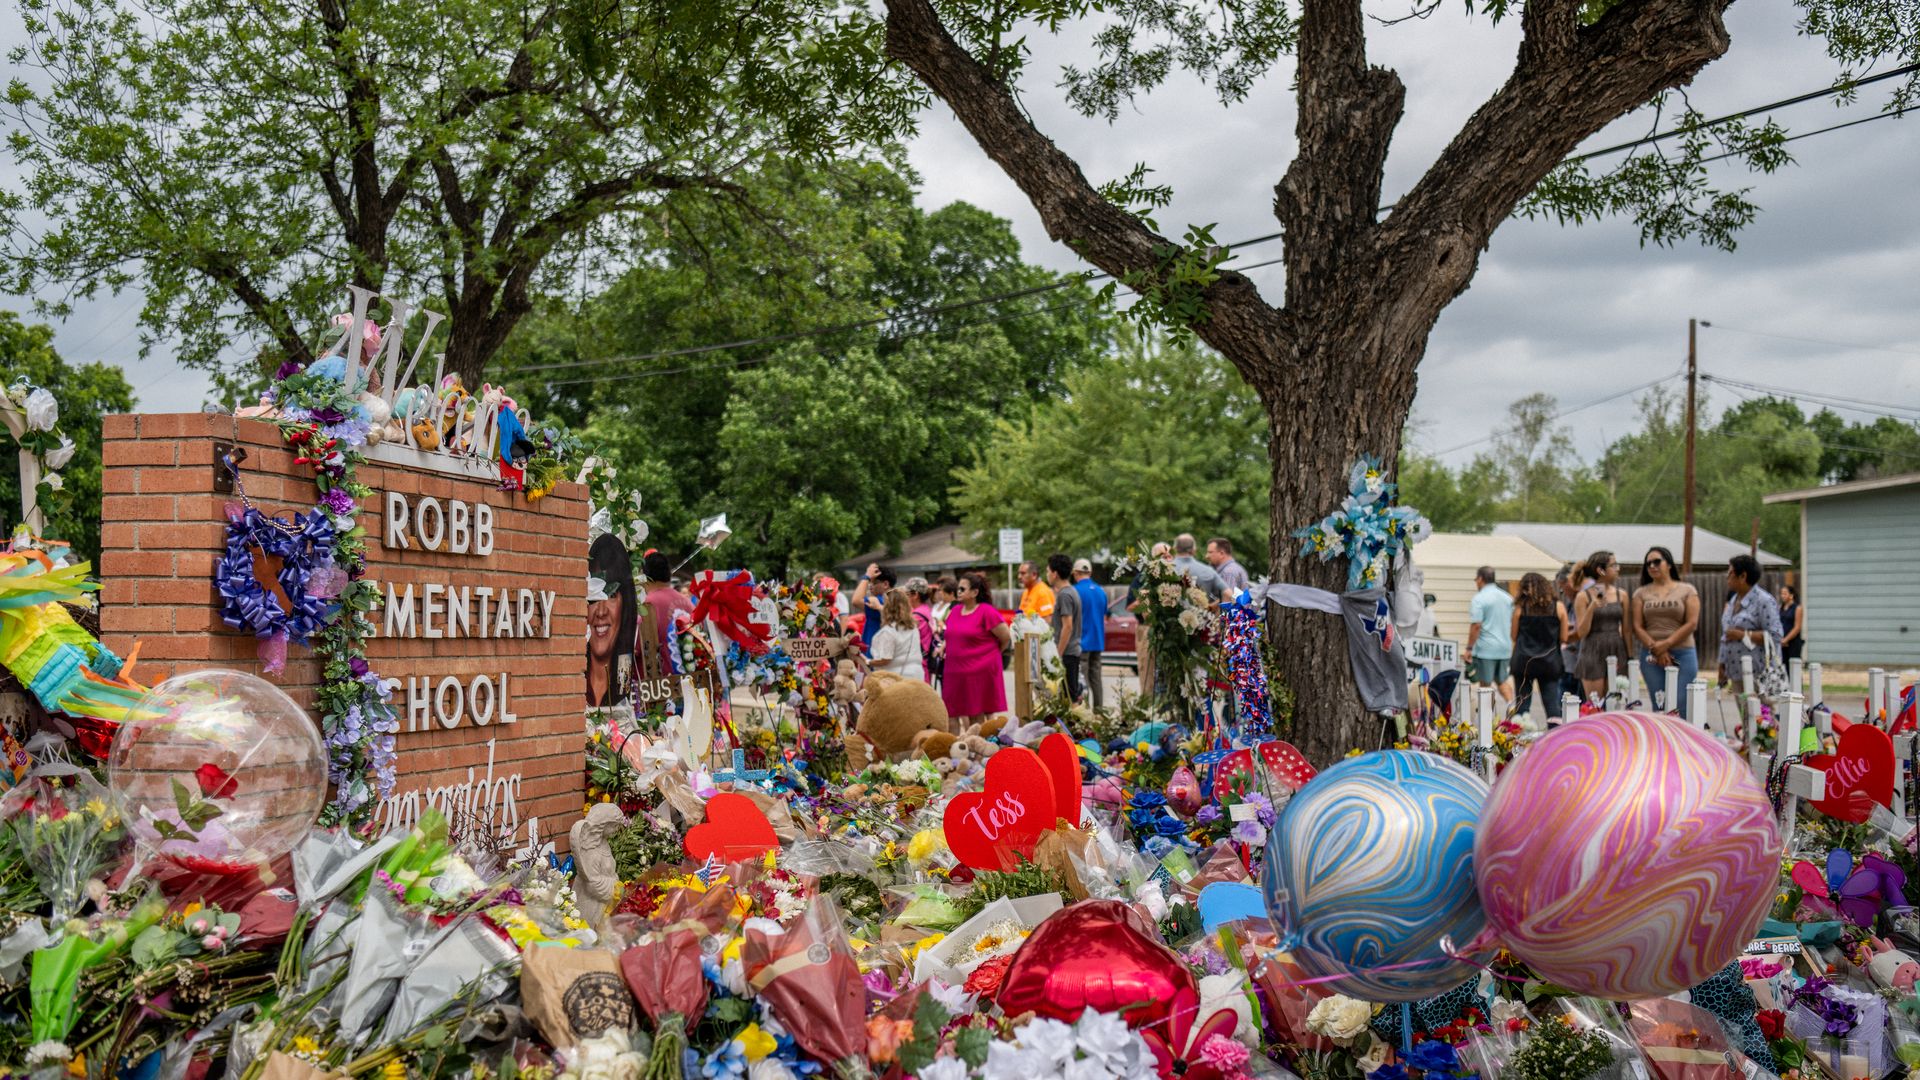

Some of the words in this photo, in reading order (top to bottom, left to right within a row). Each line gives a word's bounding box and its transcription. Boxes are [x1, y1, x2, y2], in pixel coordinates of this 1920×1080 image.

[386, 491, 494, 556] ROBB
[791, 649, 830, 658] COTULLA
[792, 641, 812, 649] CITY
[814, 640, 826, 648] OF
[1412, 641, 1441, 658] SANTA
[1443, 644, 1453, 661] FE
[386, 672, 517, 733] HOOL
[1825, 756, 1870, 799] Ellie
[962, 791, 1025, 841] Tess
[1772, 942, 1800, 953] BEARS
